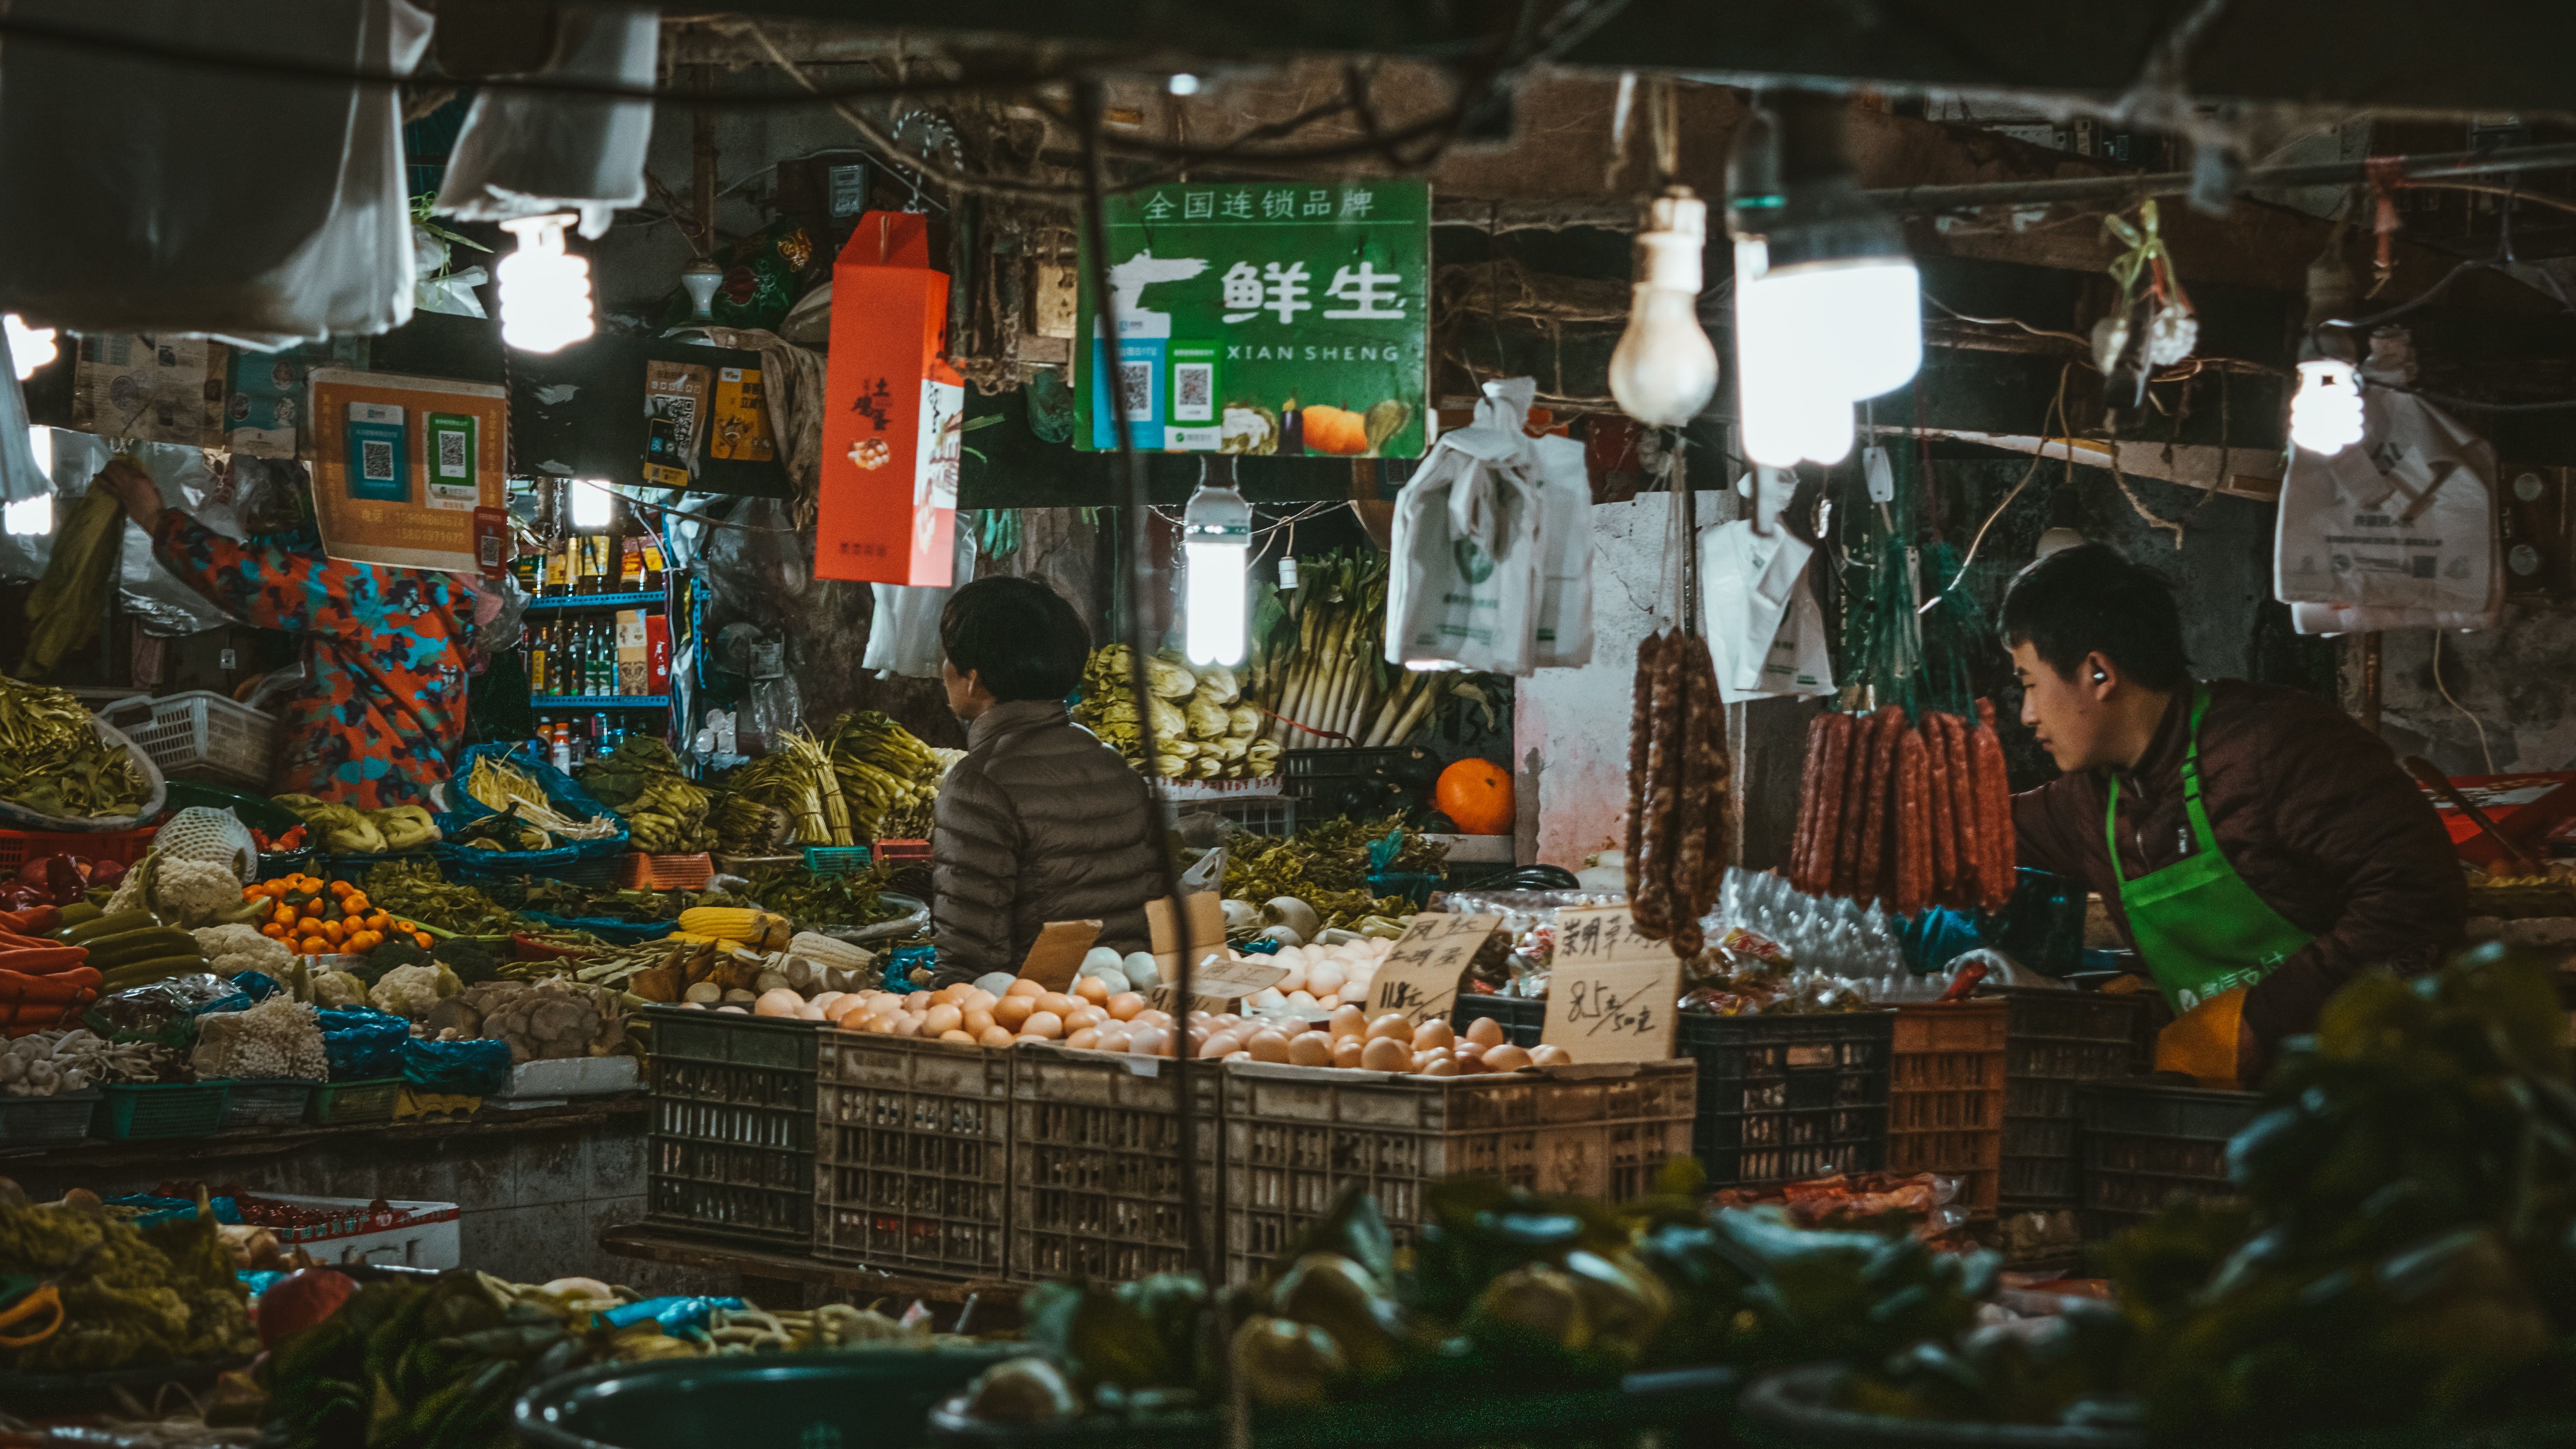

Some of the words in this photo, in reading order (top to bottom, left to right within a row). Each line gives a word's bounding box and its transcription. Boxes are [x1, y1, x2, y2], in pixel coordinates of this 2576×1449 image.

[1142, 190, 1374, 221] 全国连锁品牌
[1221, 261, 1406, 324] 鲜生
[1227, 346, 1294, 360] XIAN
[1304, 346, 1399, 361] SHENG
[1560, 914, 1669, 960] 崇明草
